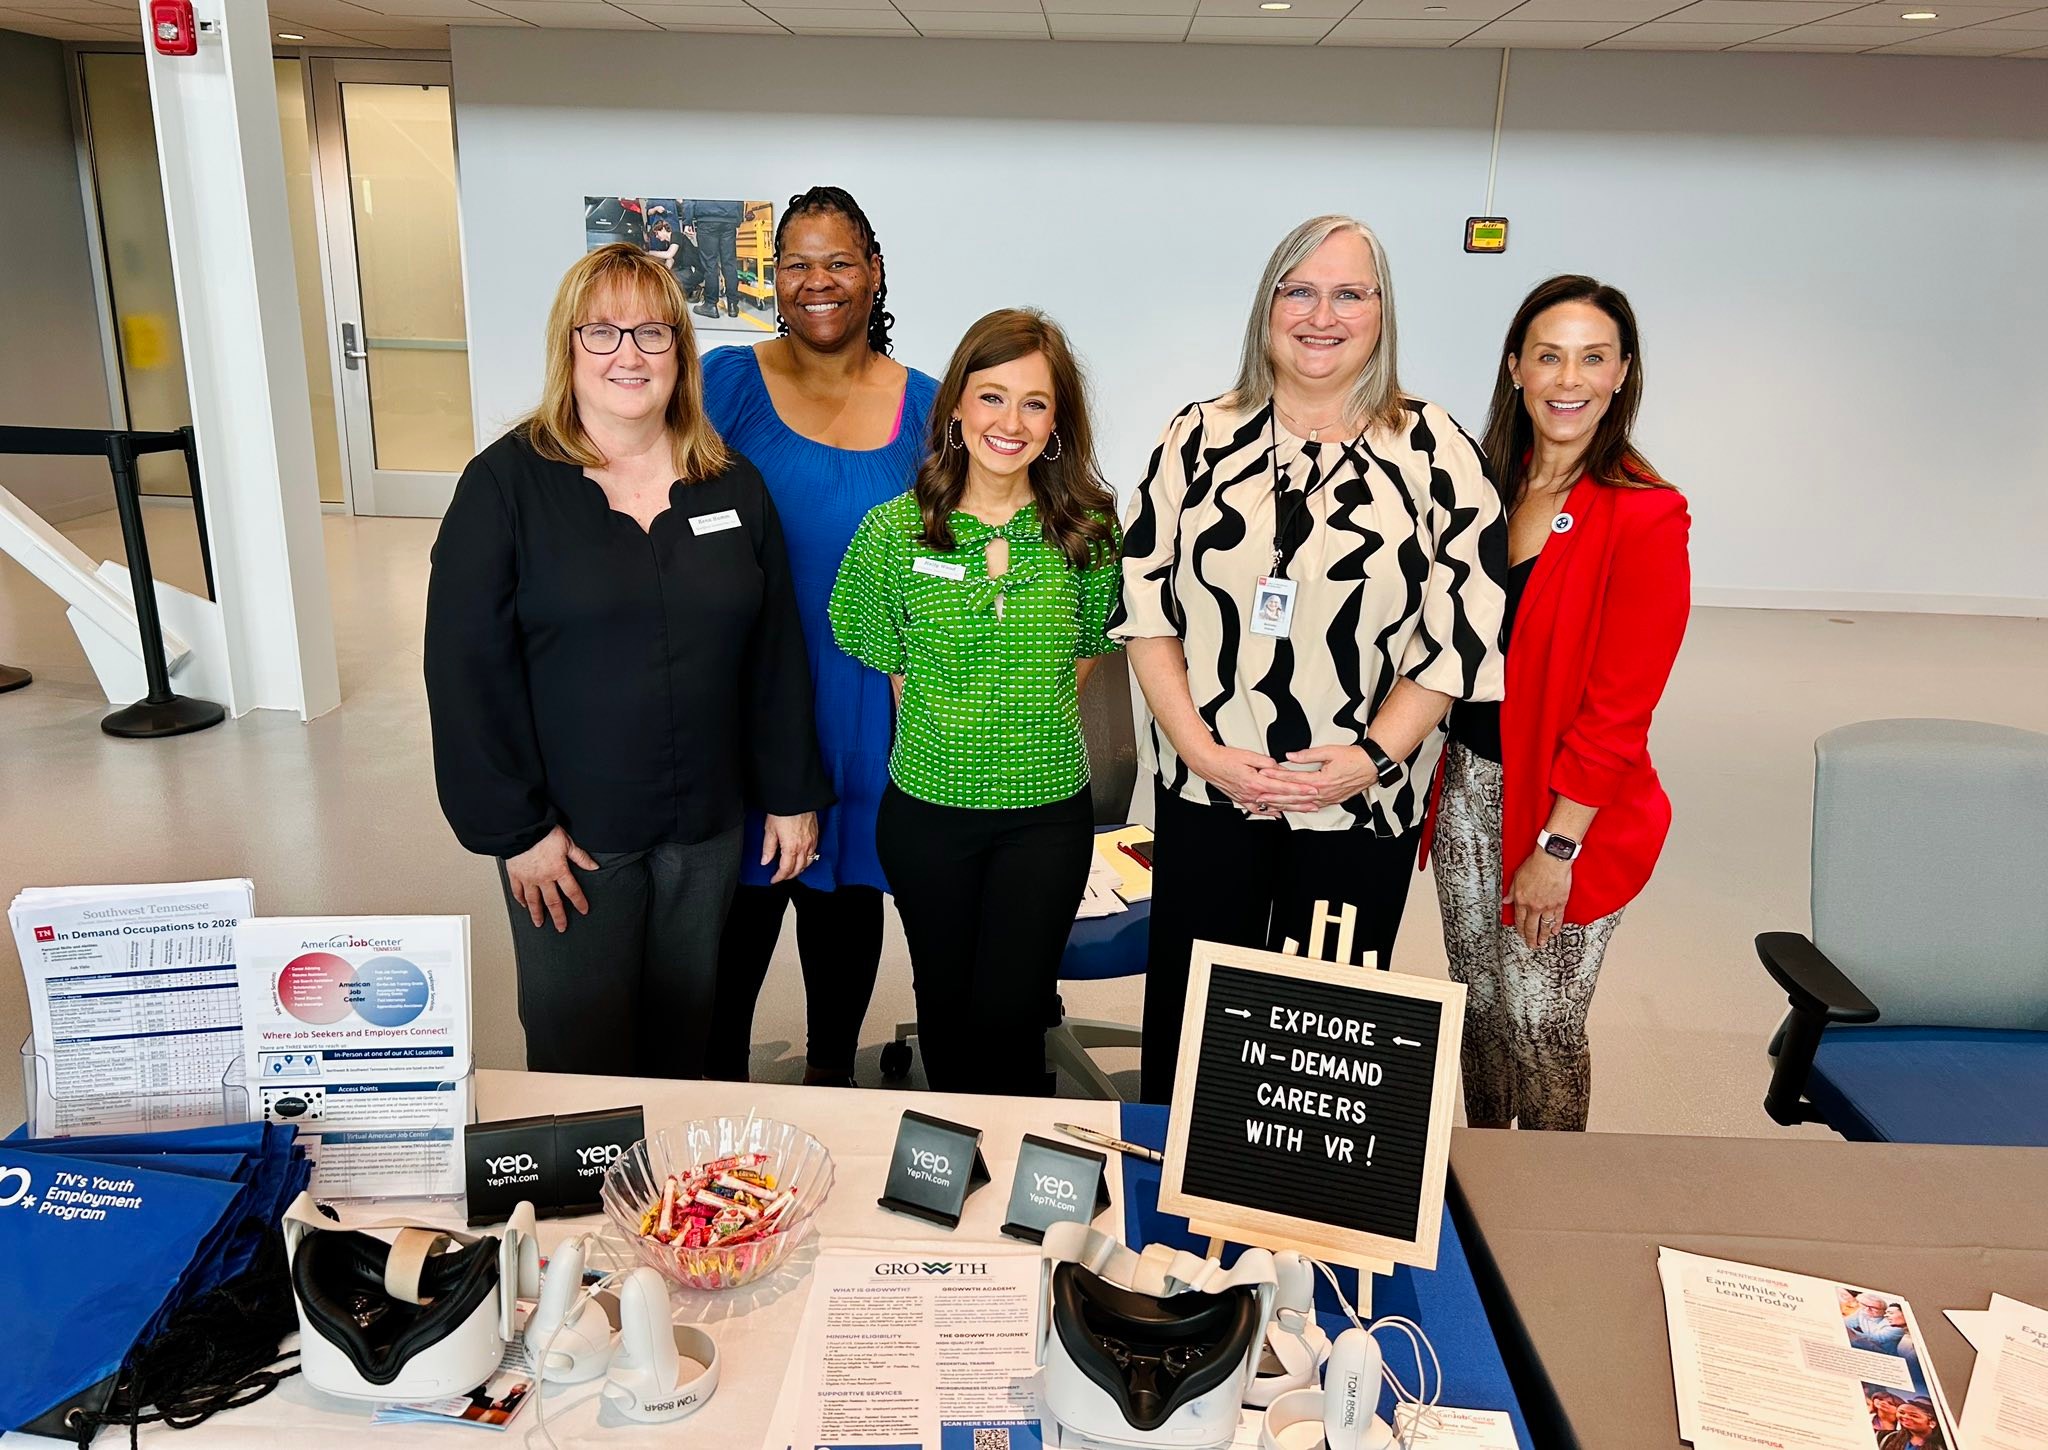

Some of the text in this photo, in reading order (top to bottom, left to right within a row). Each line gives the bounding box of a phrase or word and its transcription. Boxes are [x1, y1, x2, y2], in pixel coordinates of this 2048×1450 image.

[83, 907, 145, 920] Southwest
[149, 902, 209, 914] Tennessee
[38, 929, 51, 938] TN
[58, 932, 68, 941] In
[72, 927, 120, 940] Demand
[123, 922, 195, 936] Occupations
[198, 921, 209, 930] to
[212, 919, 237, 928] 2026
[262, 1032, 292, 1040] Where
[294, 1031, 309, 1039] Job
[311, 1030, 344, 1038] Seekers
[365, 1028, 408, 1038] Employers
[410, 1027, 448, 1036] Connect!
[1269, 1005, 1376, 1047] EXPLORE
[334, 1050, 363, 1058] In-Person
[415, 1048, 443, 1056] Locations
[1241, 1039, 1383, 1087] IN-DEMAND
[1256, 1083, 1367, 1125] CAREERS
[346, 1132, 368, 1140] Virtual
[1245, 1118, 1303, 1153] WITH
[1324, 1134, 1355, 1164] VR
[55, 1172, 135, 1193] TN's Youth
[486, 1173, 539, 1187] YepTN.com
[906, 1166, 950, 1188] YepTN.com
[45, 1186, 142, 1209] Employment
[1029, 1192, 1076, 1213] YepTN.com
[38, 1201, 107, 1221] Program
[1706, 1275, 1805, 1303] Earn While You
[1715, 1286, 1798, 1312] Learn Today
[1347, 1375, 1358, 1398] TQM
